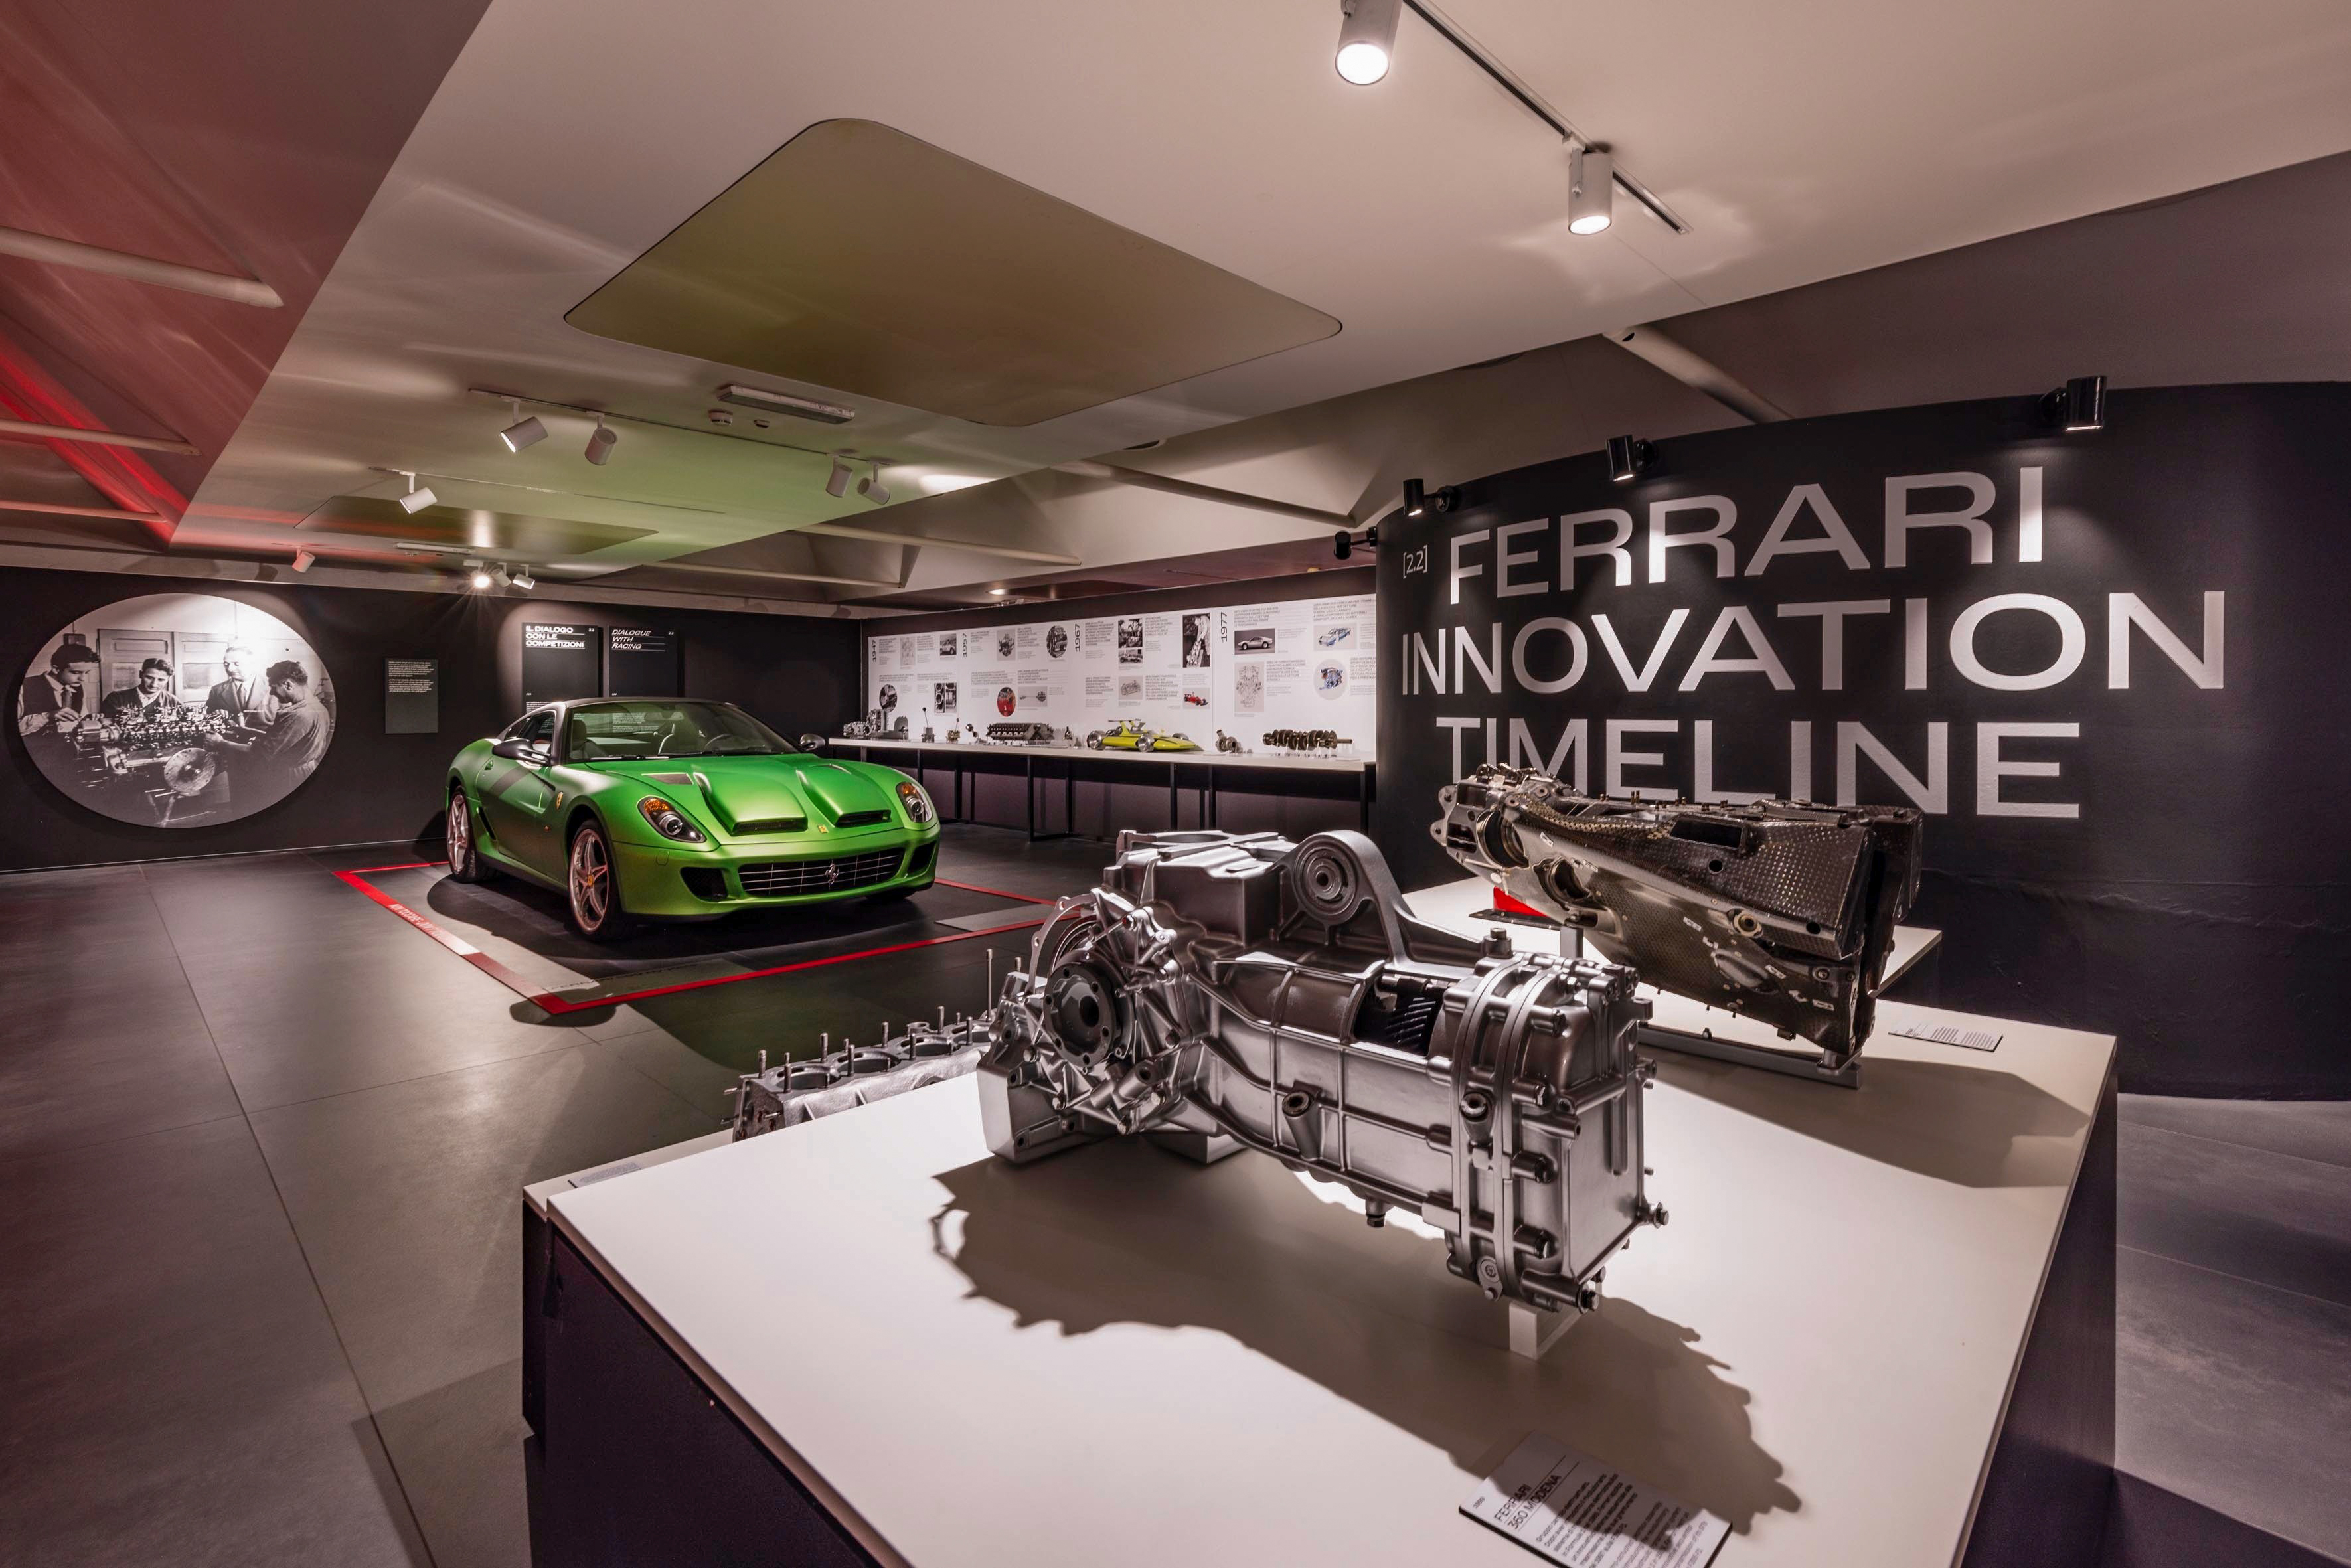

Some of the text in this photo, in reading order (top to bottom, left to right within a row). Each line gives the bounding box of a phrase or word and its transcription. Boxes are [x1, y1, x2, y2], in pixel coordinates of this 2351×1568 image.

[1403, 544, 1428, 579] [2.2]
[1450, 466, 2044, 605] FERRARI
[1402, 590, 2225, 696] INNOVATION
[1435, 717, 2081, 819] TIMELINE
[1495, 1484, 1532, 1522] FERRARI
[1508, 1474, 1562, 1529] 360 MODENA
